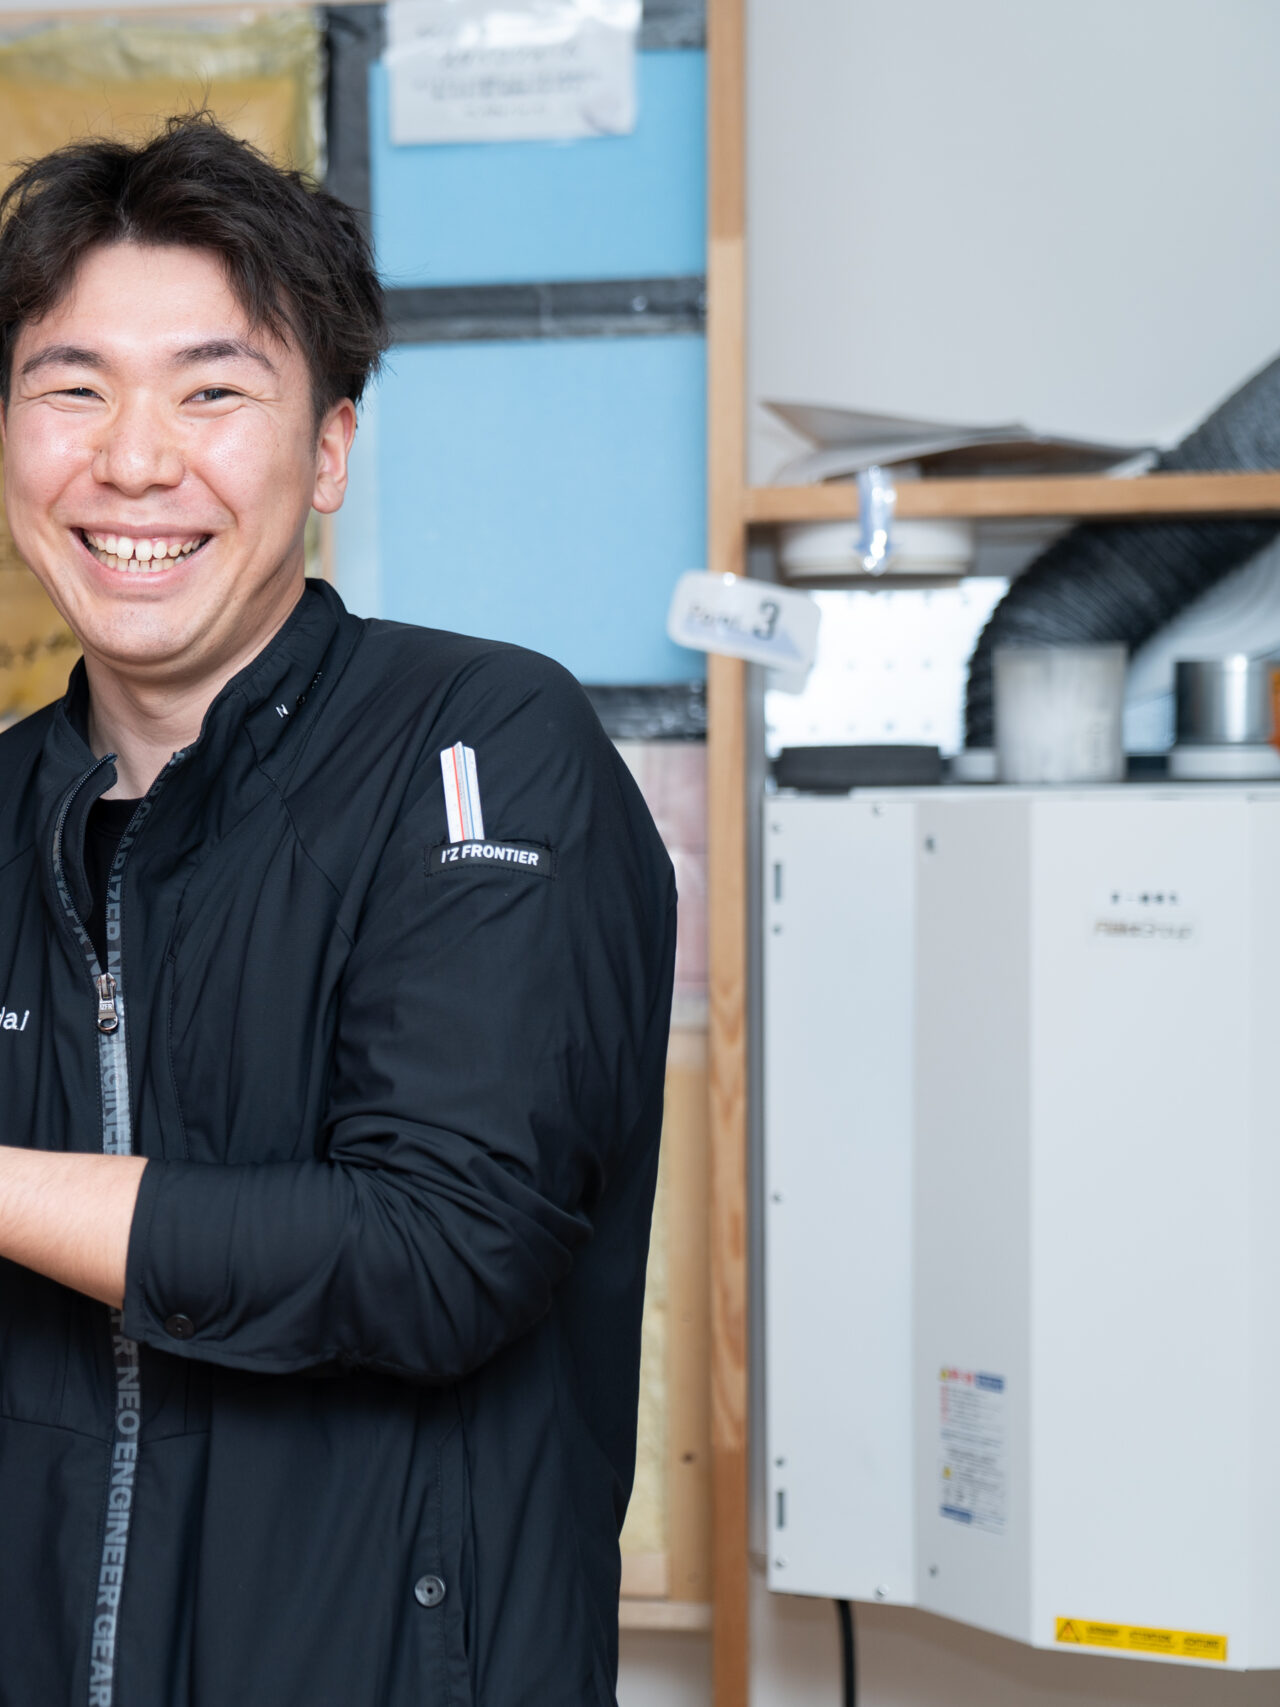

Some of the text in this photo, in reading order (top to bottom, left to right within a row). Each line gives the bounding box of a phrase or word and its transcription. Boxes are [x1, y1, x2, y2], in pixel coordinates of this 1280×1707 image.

[752, 600, 780, 642] 3
[441, 844, 540, 866] I'Z FRONTIER
[116, 1365, 141, 1436] NEO
[96, 1441, 138, 1606] ENGINEER
